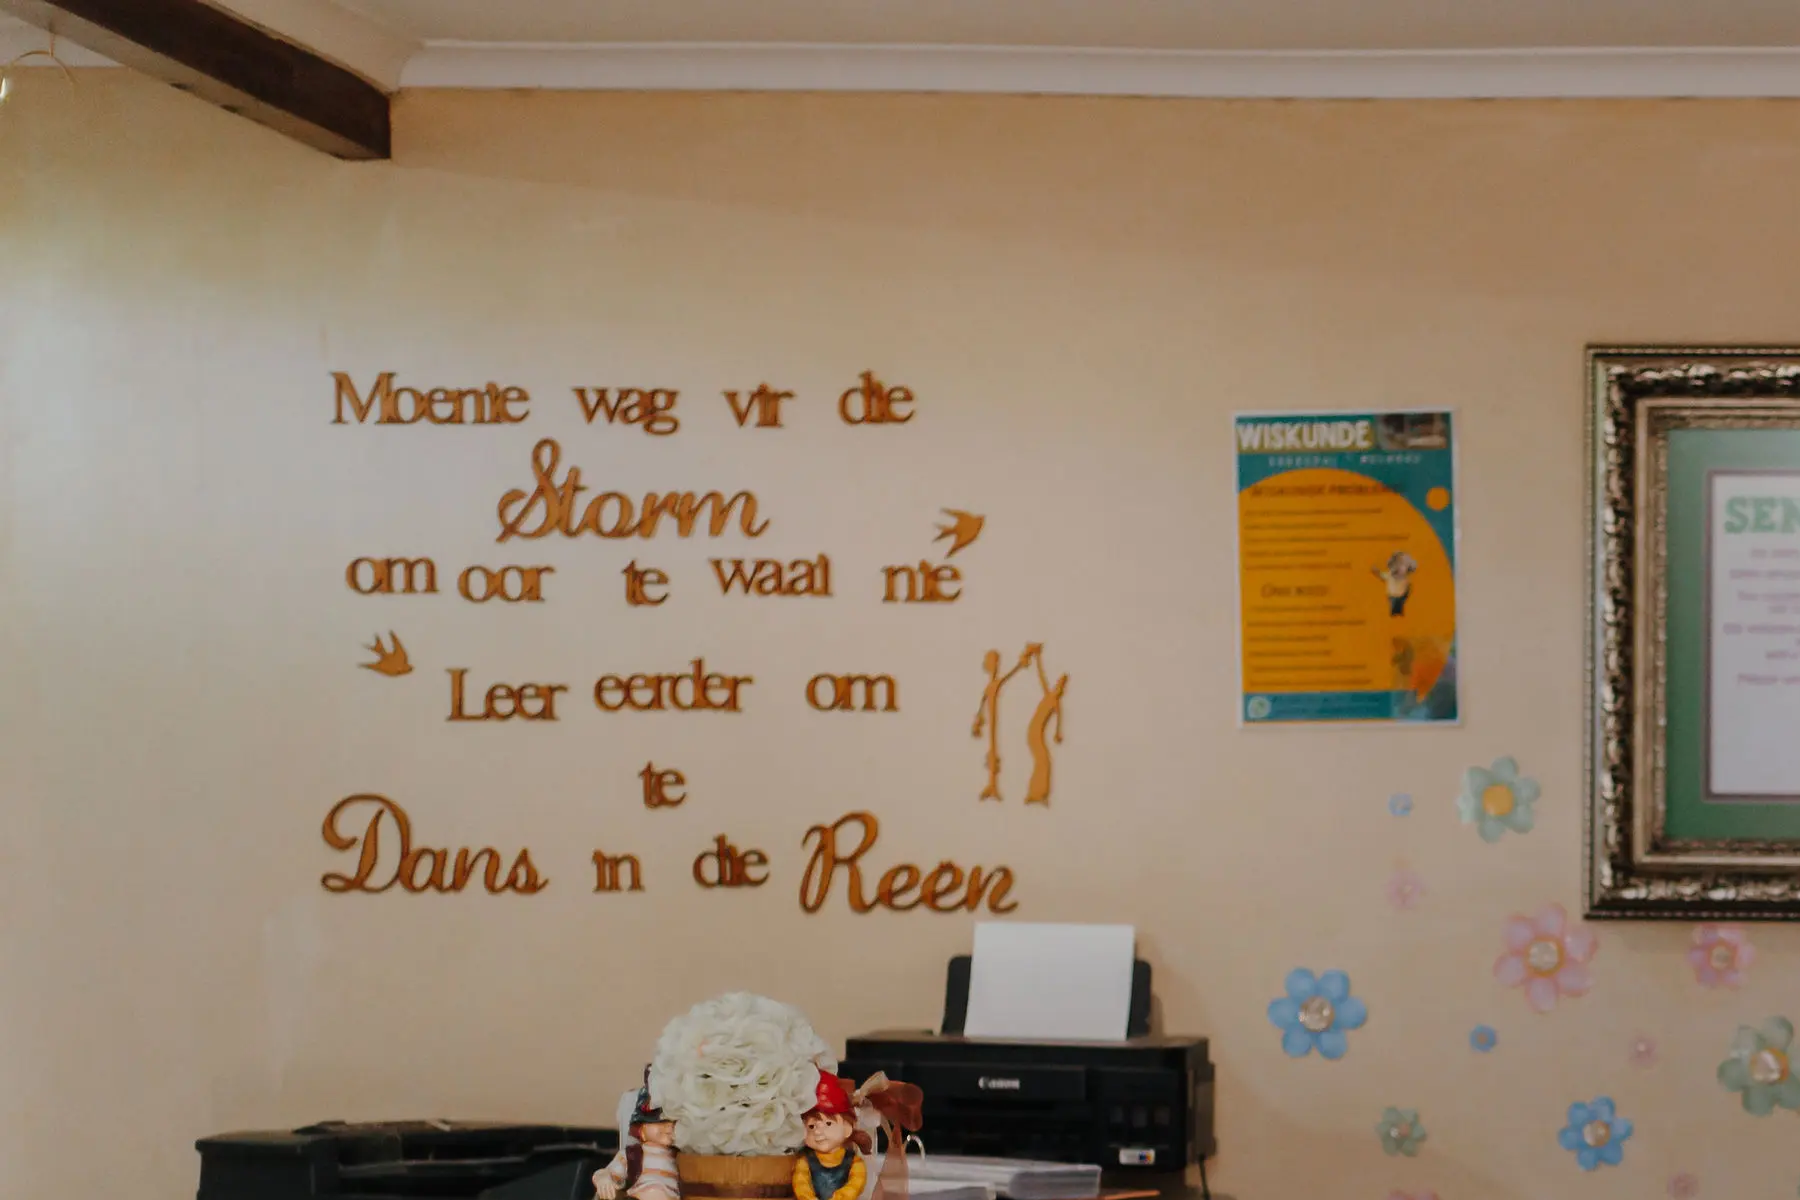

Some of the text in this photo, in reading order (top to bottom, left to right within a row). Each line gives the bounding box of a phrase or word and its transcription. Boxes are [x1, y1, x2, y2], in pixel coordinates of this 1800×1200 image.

[330, 370, 916, 435] Moenie wag vir die
[1238, 421, 1371, 449] WISKUNDE
[497, 438, 769, 543] Storm
[345, 555, 439, 594] om
[456, 563, 557, 602] oor
[620, 558, 671, 606] te
[881, 555, 962, 603] nie
[445, 657, 900, 723] Leer eerder om
[637, 762, 688, 809] te
[320, 793, 549, 895] Dans
[592, 849, 644, 894] in
[692, 835, 769, 889] die
[978, 1076, 1020, 1090] Canon
